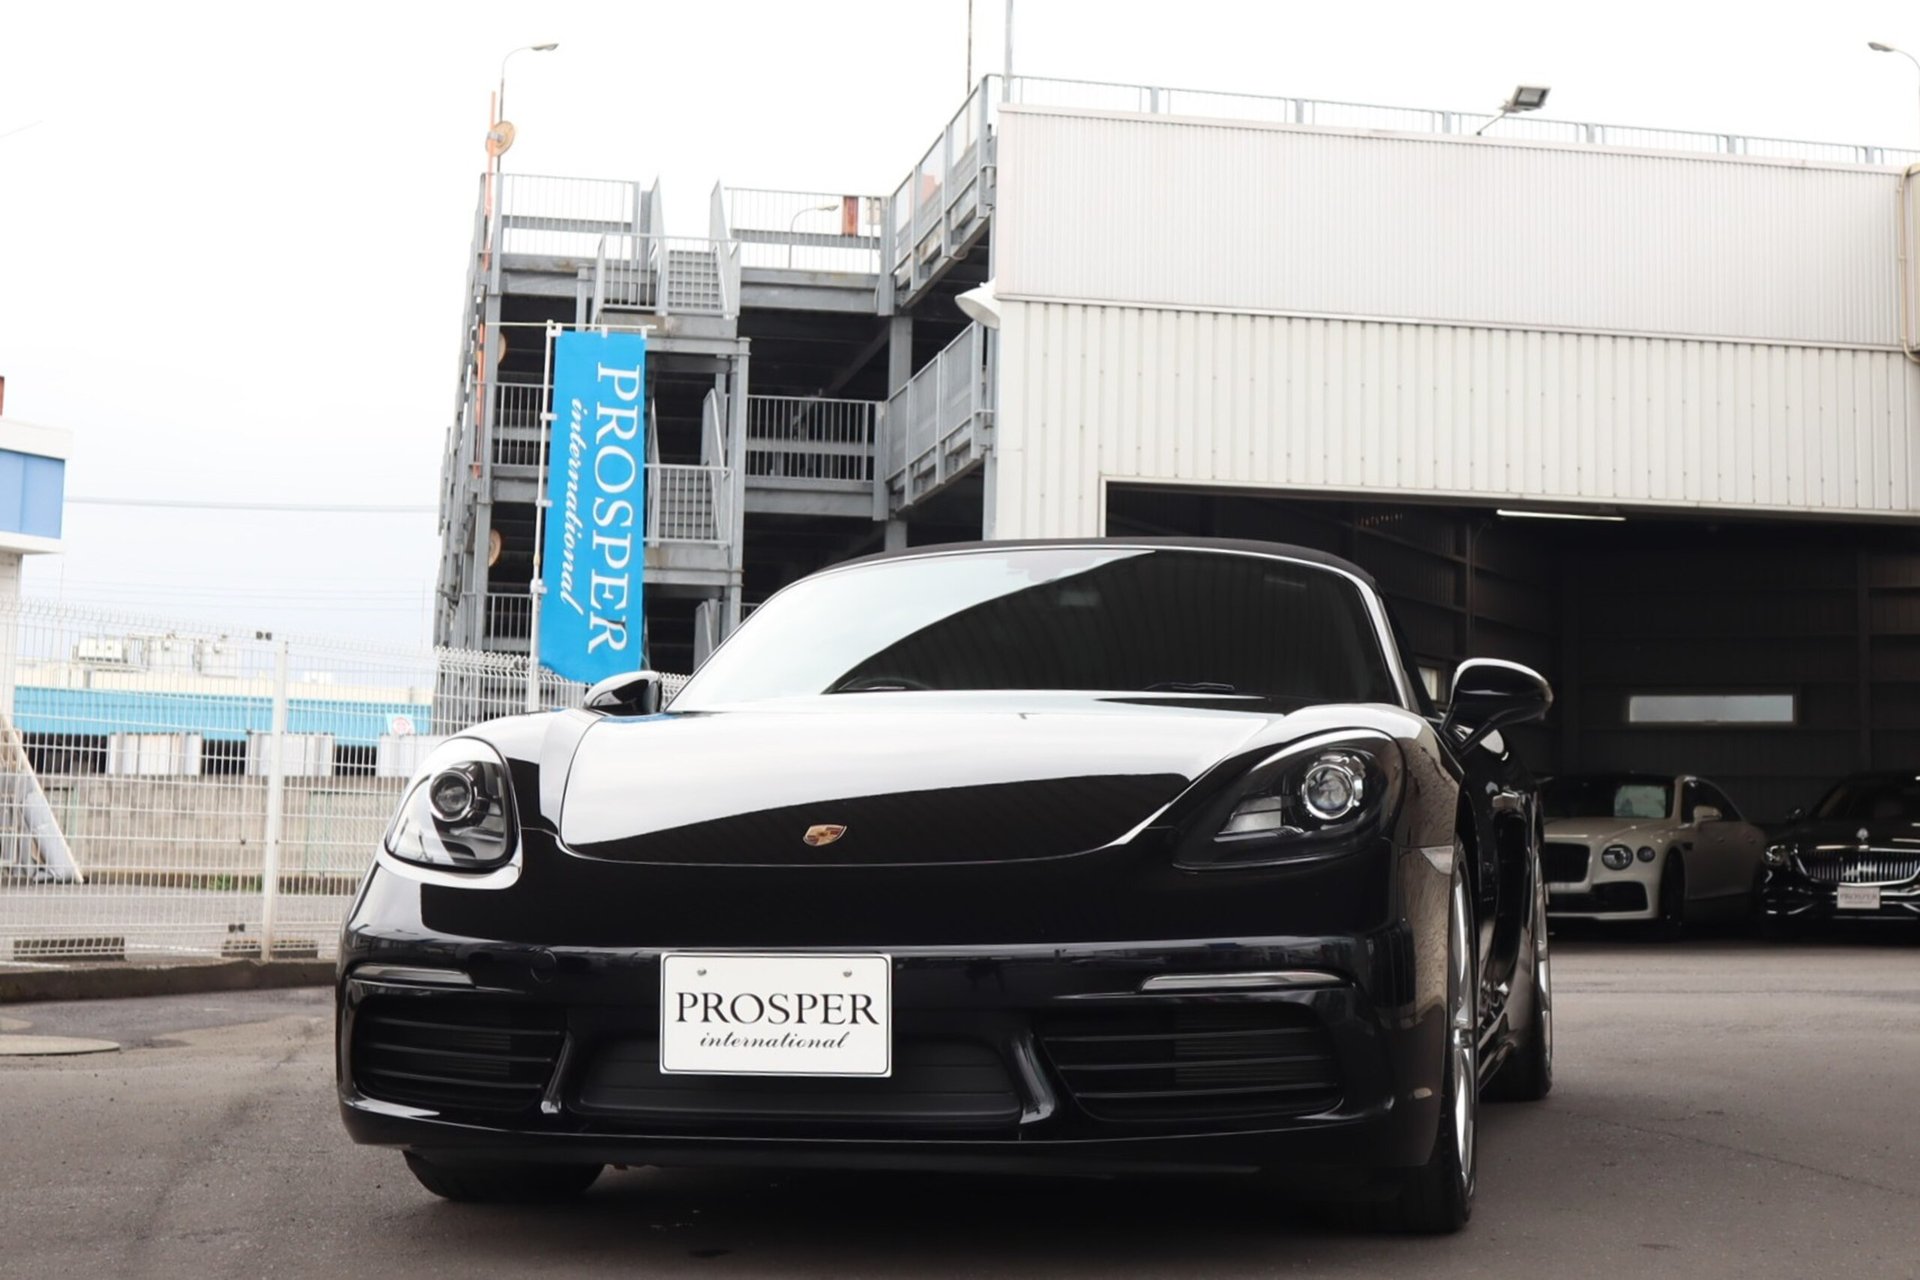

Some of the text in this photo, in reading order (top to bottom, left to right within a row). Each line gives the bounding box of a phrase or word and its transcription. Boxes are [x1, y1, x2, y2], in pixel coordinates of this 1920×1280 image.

[560, 397, 588, 615] international
[587, 362, 641, 654] PROSPER
[676, 992, 880, 1025] PROSPER
[700, 1031, 850, 1049] international
